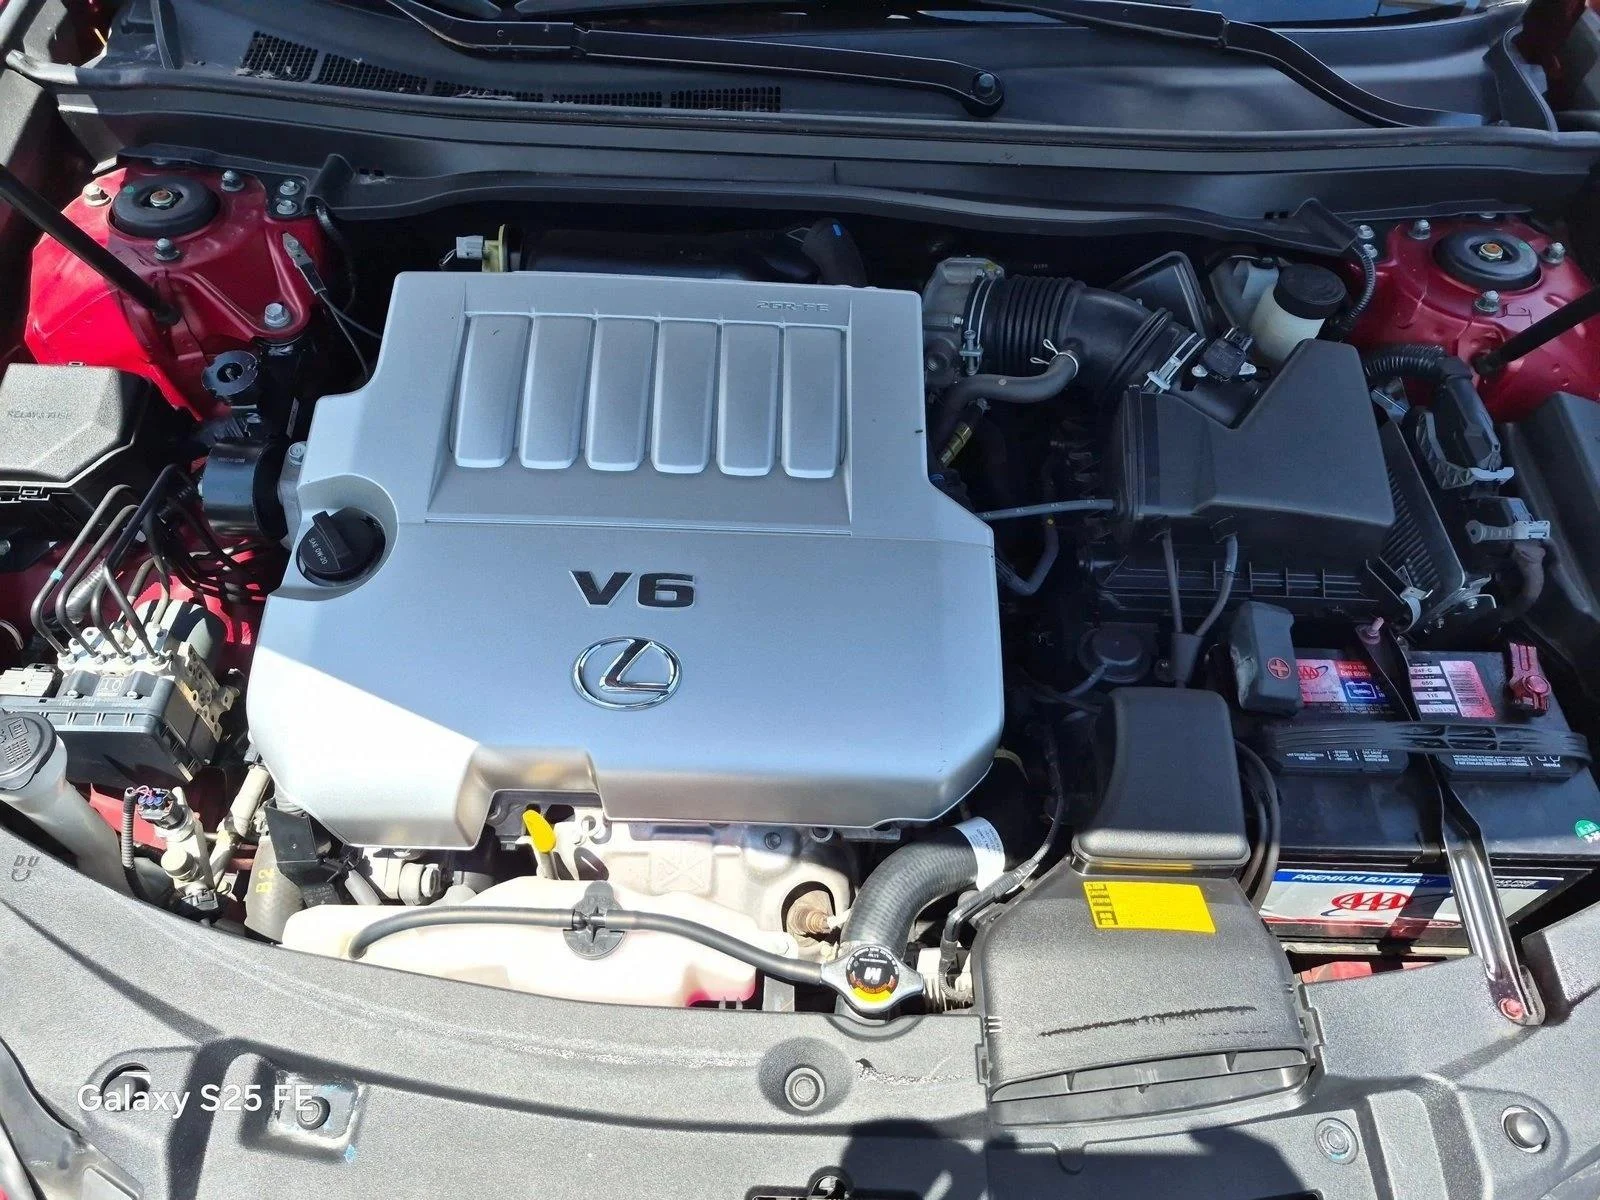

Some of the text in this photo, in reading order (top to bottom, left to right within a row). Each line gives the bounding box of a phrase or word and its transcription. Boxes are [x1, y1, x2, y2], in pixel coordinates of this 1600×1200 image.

[568, 570, 696, 608] V6
[1292, 873, 1437, 886] PREMIUM BATTERY
[1333, 892, 1412, 911] AAA
